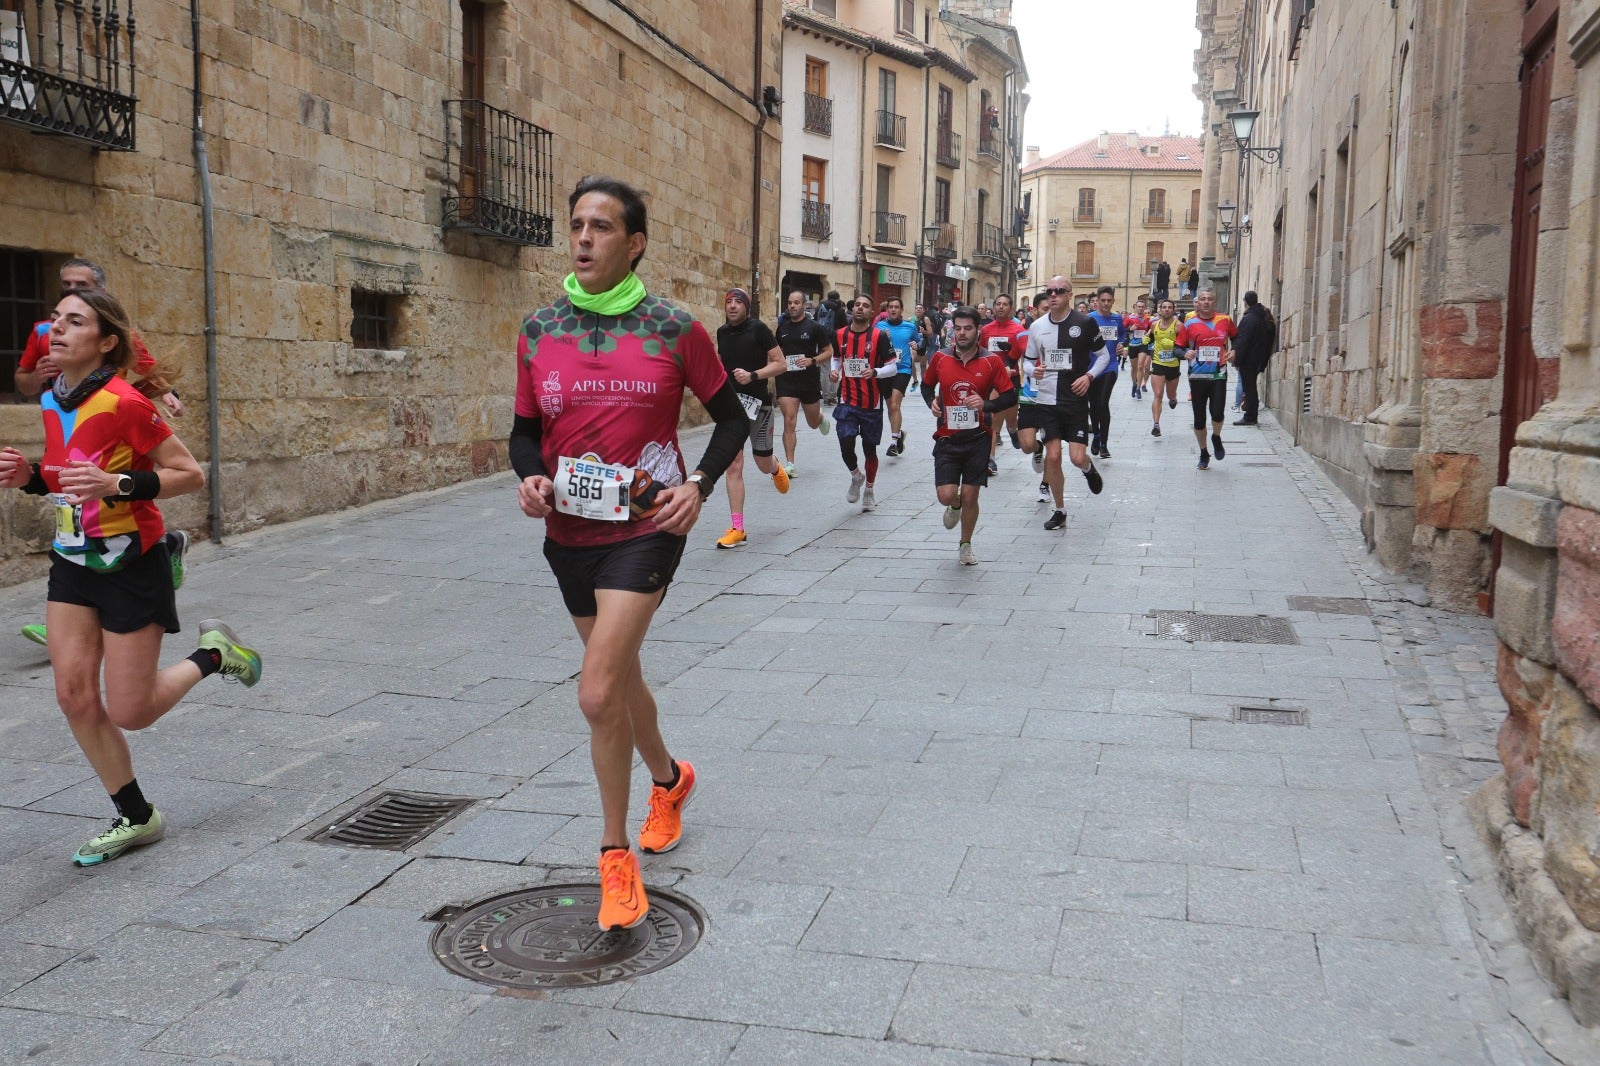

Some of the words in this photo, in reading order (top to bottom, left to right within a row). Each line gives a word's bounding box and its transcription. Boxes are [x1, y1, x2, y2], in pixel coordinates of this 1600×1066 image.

[571, 380, 605, 392] APIS
[610, 380, 656, 394] DURII
[952, 411, 969, 422] 758
[568, 474, 604, 501] 589
